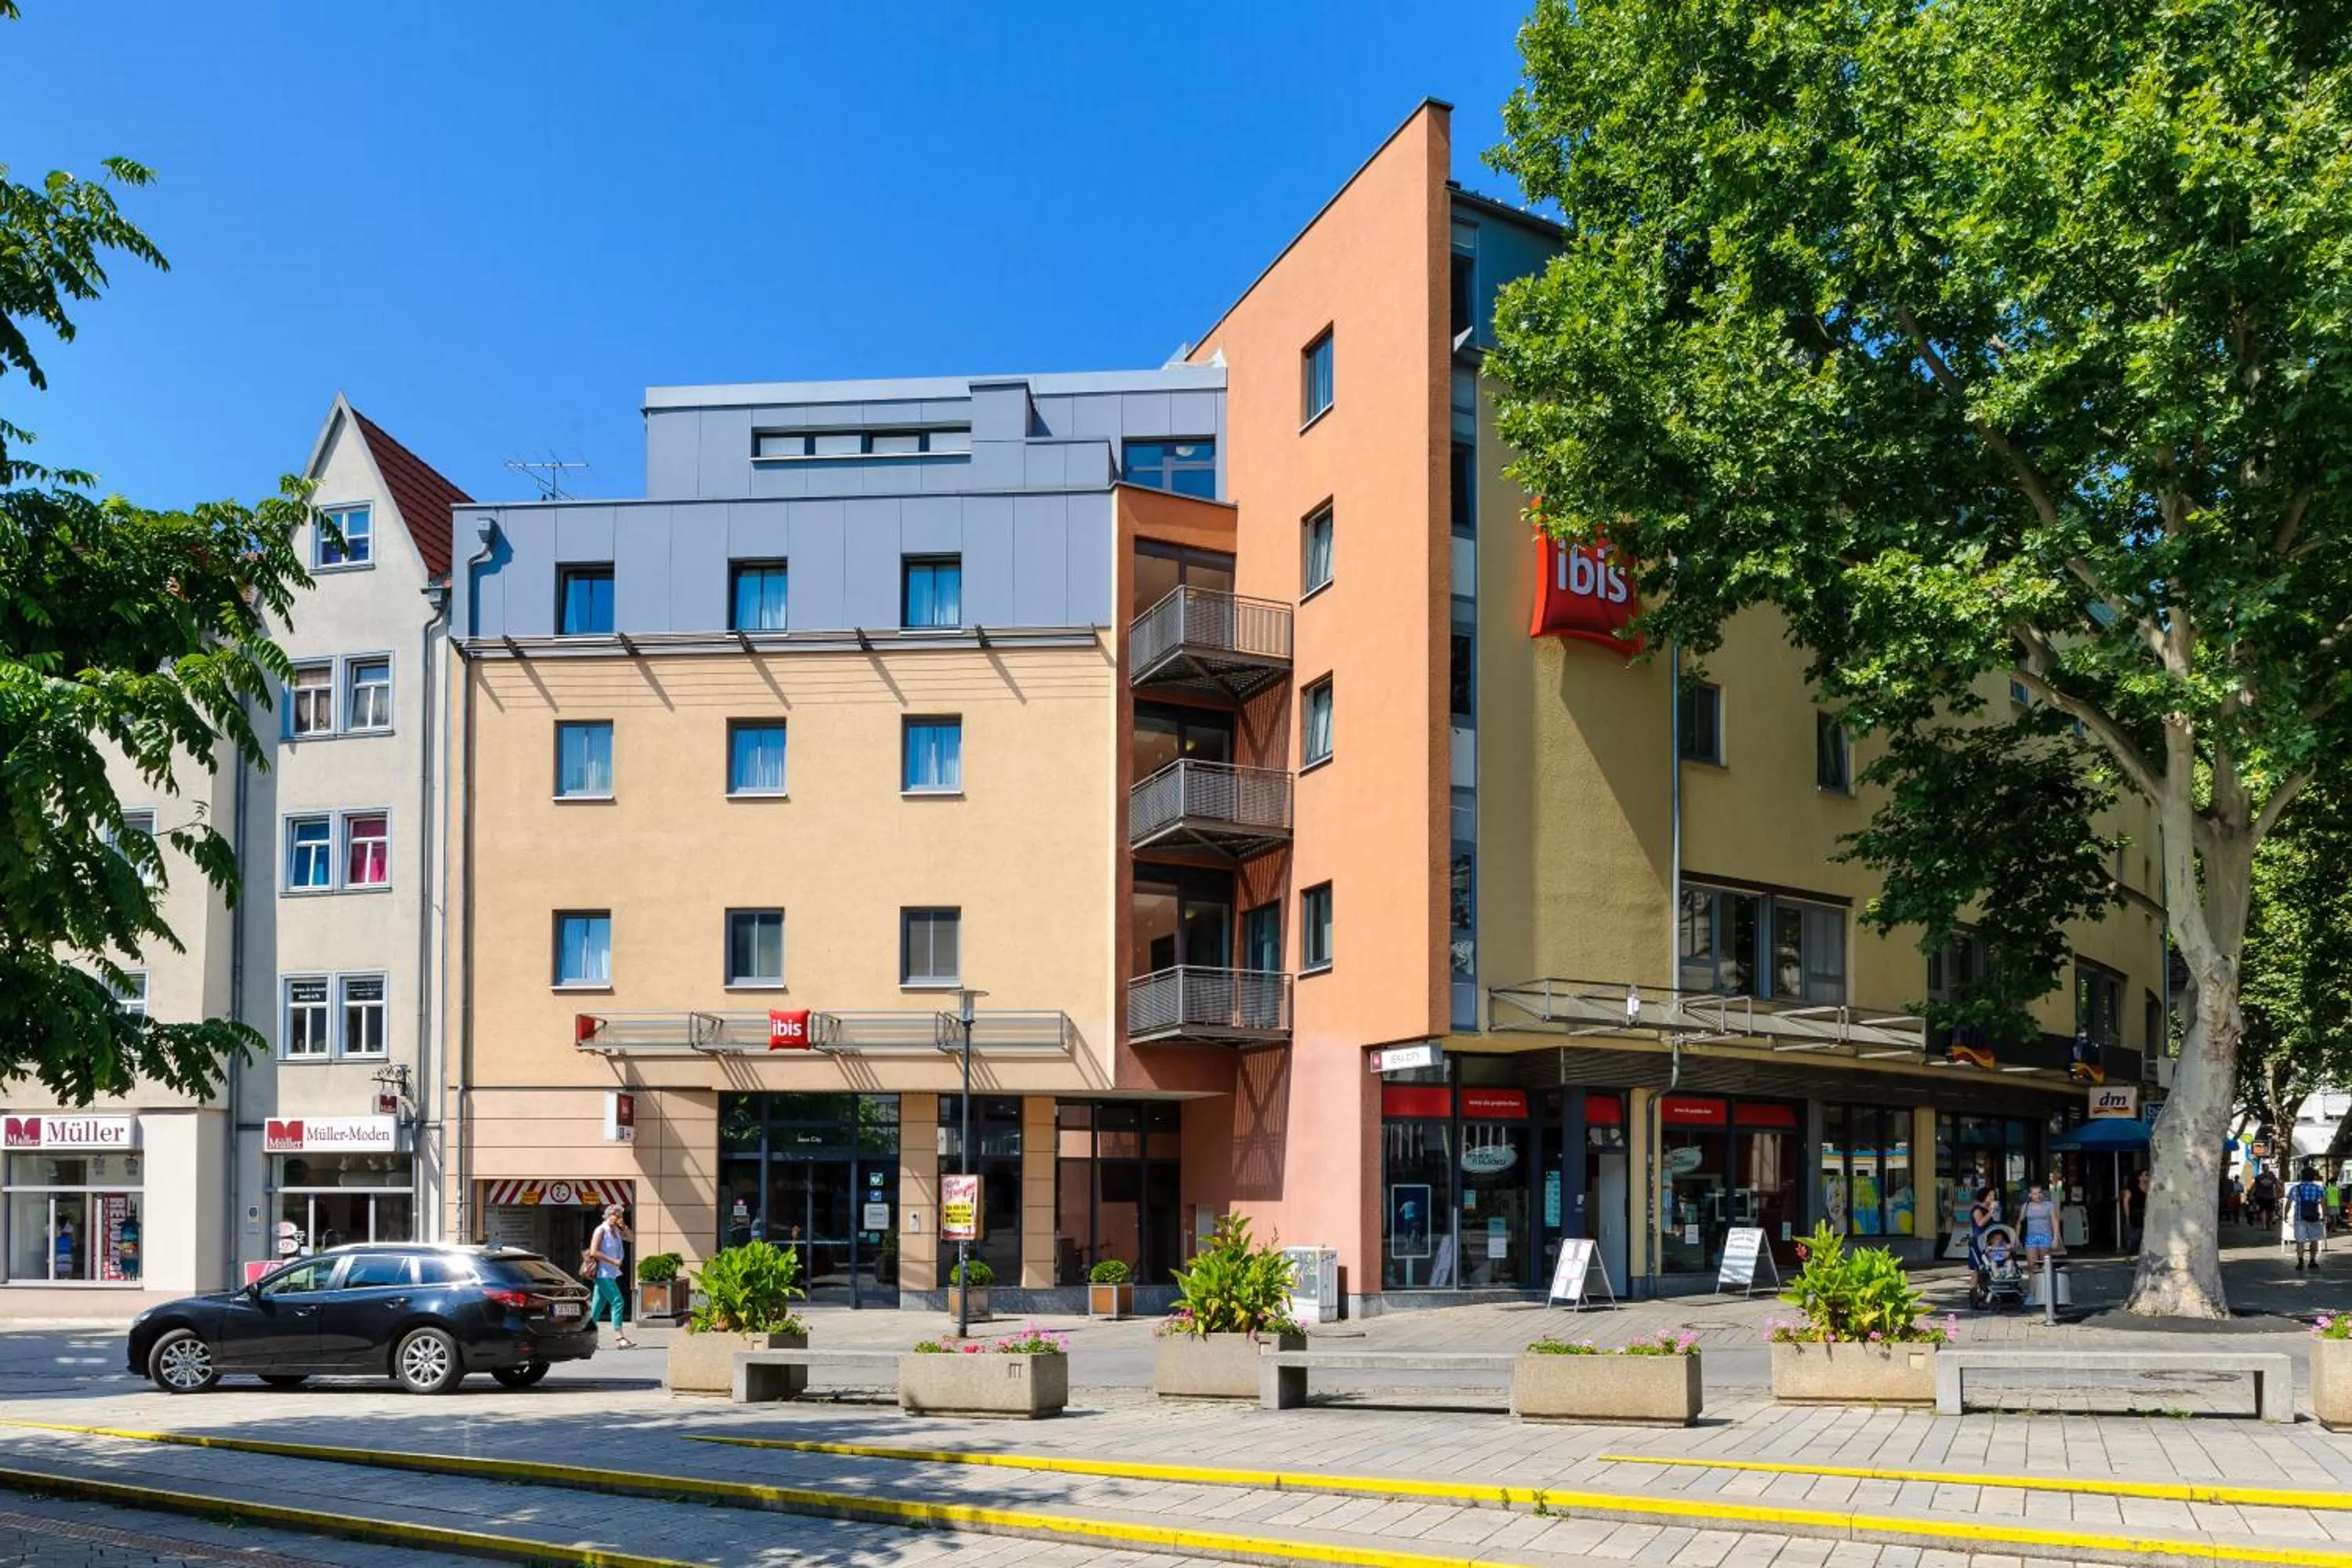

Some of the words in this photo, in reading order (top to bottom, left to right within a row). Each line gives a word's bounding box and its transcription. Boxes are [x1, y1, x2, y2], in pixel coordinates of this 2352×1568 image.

[1557, 539, 1628, 604] ibis
[772, 1018, 802, 1036] ibis
[2099, 1091, 2127, 1106] dm
[46, 1120, 125, 1142] Müller
[306, 1124, 390, 1142] Müller-Moden
[268, 1137, 303, 1149] Müller
